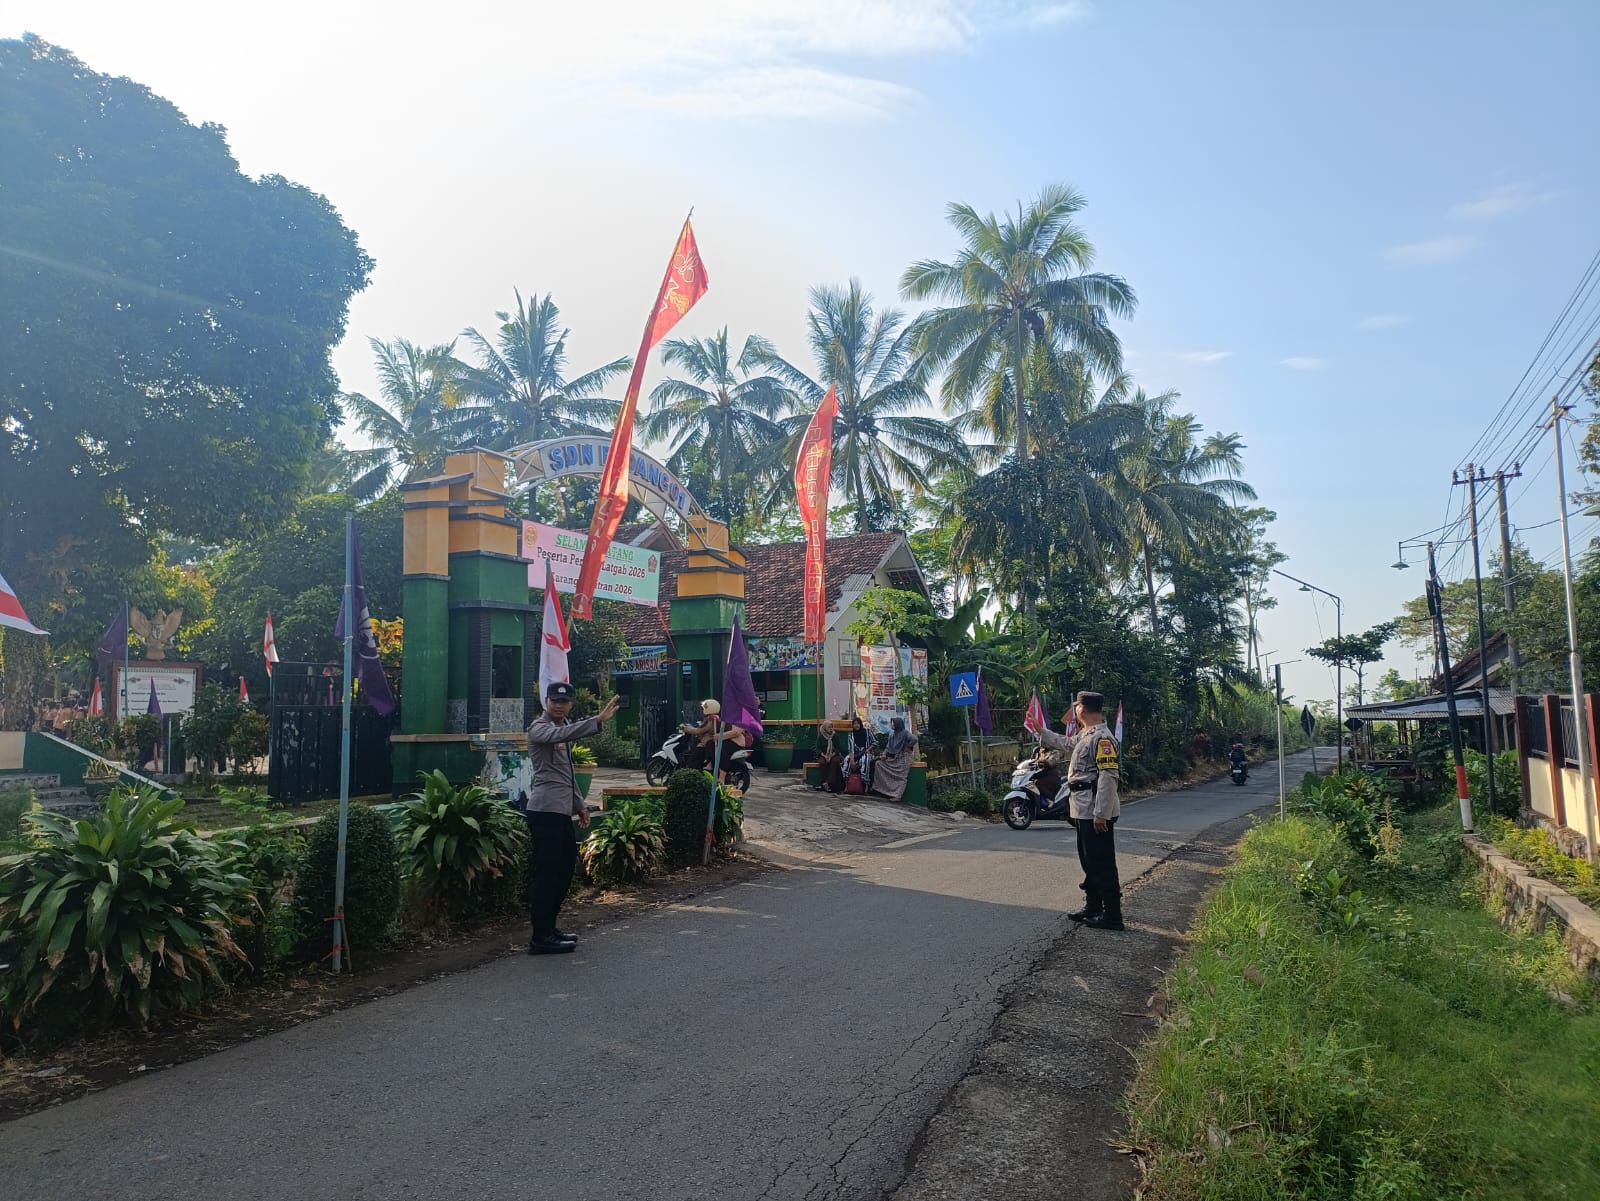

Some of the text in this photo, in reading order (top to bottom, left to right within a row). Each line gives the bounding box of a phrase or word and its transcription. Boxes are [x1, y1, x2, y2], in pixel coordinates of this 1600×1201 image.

[551, 444, 594, 471] SDN
[537, 547, 567, 563] Peserta
[628, 566, 646, 579] 2026
[555, 575, 579, 588] arang
[615, 583, 632, 595] 2026
